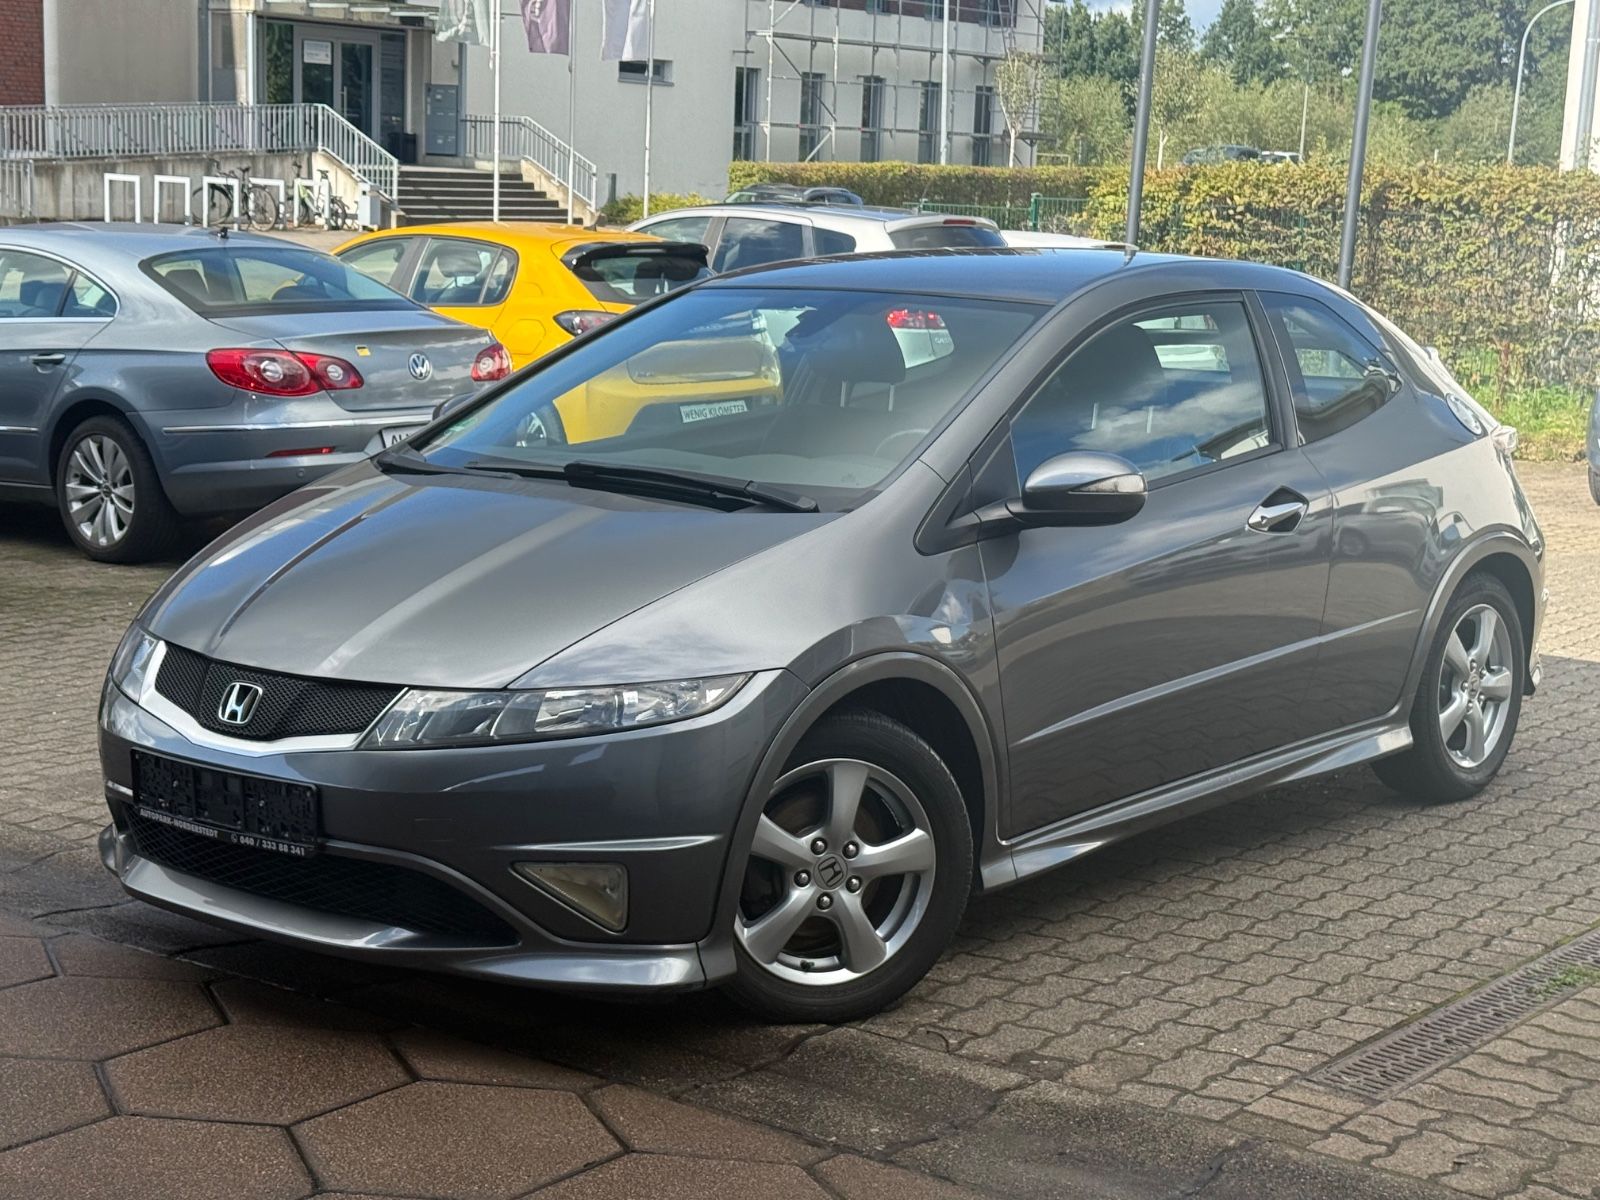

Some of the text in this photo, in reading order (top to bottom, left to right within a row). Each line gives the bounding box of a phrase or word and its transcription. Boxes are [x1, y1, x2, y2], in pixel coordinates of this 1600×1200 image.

[683, 407, 708, 421] WENIG
[239, 835, 254, 846] 040
[262, 840, 277, 850] 333
[290, 845, 305, 857] 341
